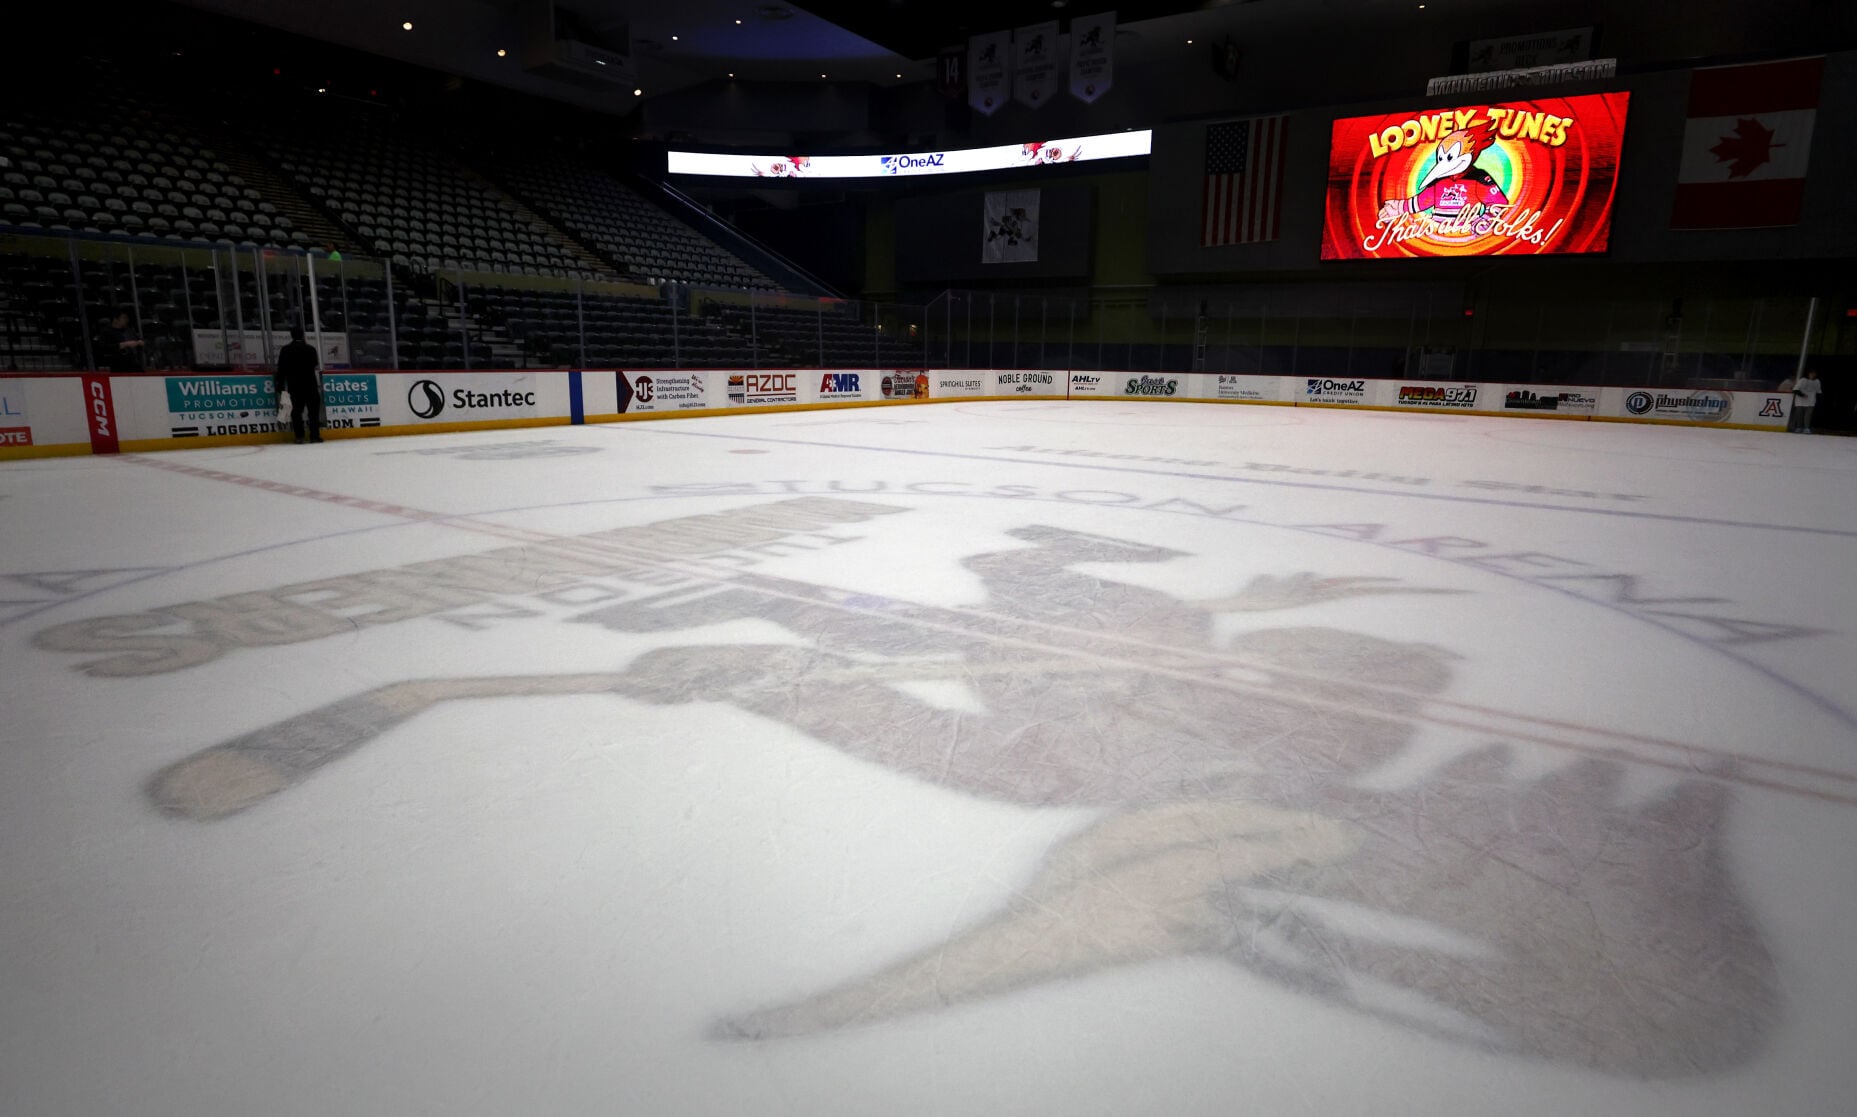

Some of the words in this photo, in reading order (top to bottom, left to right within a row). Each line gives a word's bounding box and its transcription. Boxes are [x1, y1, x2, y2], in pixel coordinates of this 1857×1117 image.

[1368, 109, 1478, 159] LOONEY
[1486, 107, 1576, 148] TUNES
[899, 153, 945, 168] OneAZ
[1438, 202, 1482, 236] all
[1475, 203, 1564, 246] Folks!
[746, 374, 796, 392] AZDC
[820, 373, 861, 393] AMR
[998, 374, 1020, 384] NOBLE
[1022, 373, 1053, 385] GROUND
[1126, 379, 1177, 396] SPORTS
[1324, 380, 1364, 391] OneAZ
[178, 381, 258, 397] Williams
[1016, 384, 1032, 392] coffee
[1399, 387, 1445, 401] MEGA
[453, 389, 536, 408] Stantec
[90, 381, 110, 437] CCM
[180, 412, 234, 421] TUCSON
[332, 406, 373, 414] HAWAII
[1759, 398, 1783, 418] A
[762, 478, 1250, 516] TUCSON
